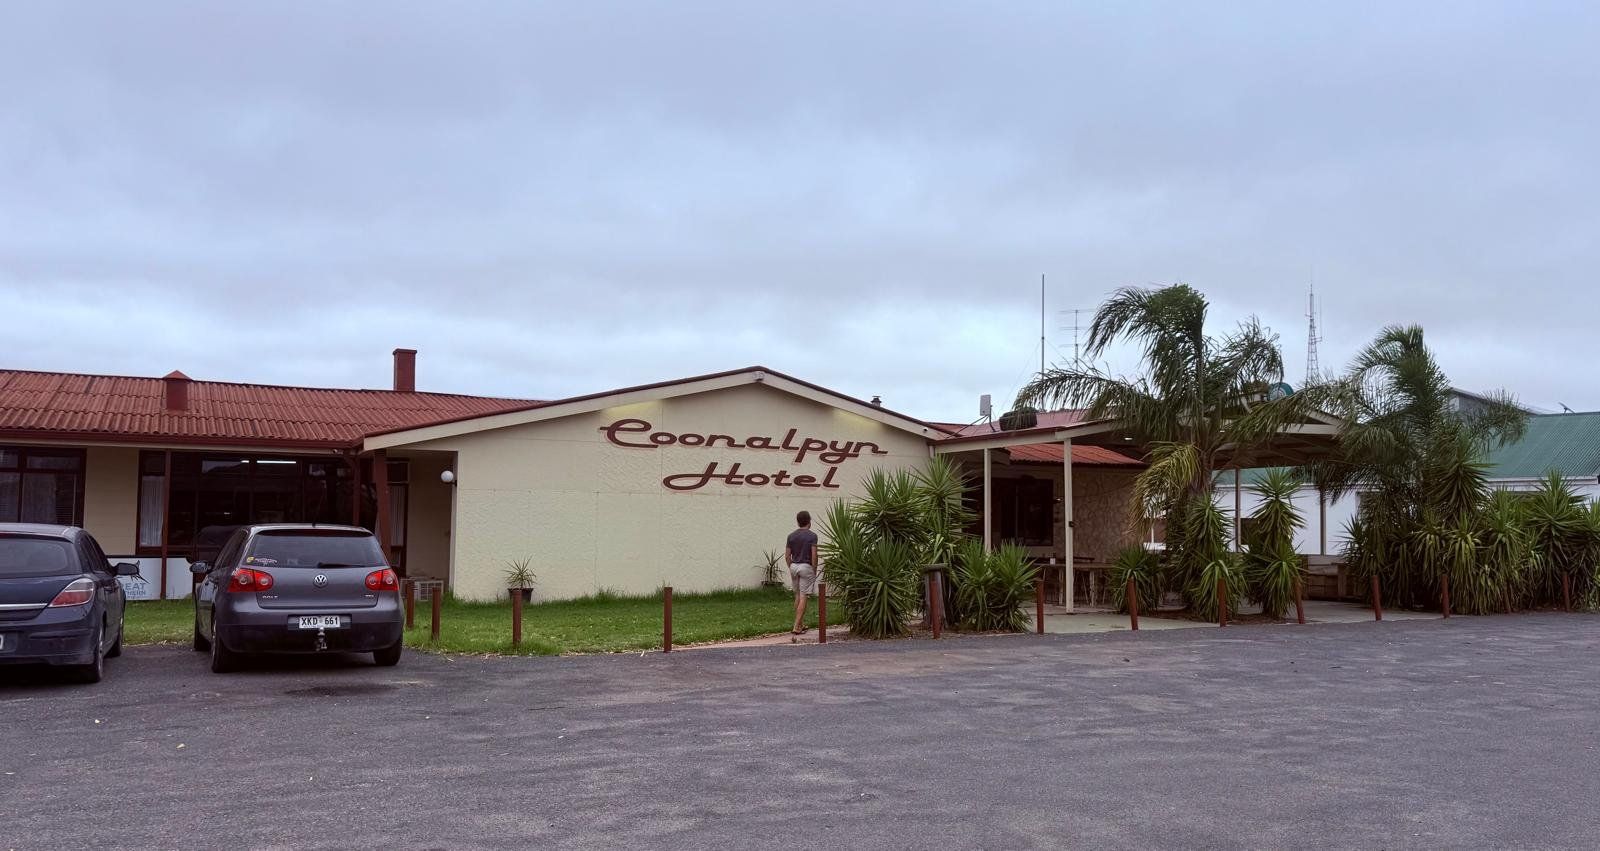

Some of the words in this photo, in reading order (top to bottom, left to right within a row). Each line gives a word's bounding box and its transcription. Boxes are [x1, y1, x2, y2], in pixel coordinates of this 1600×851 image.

[599, 418, 888, 465] Coonalpyn
[662, 461, 840, 491] Hotel
[125, 582, 146, 590] EAT
[301, 617, 318, 626] XKD
[324, 616, 338, 625] 661
